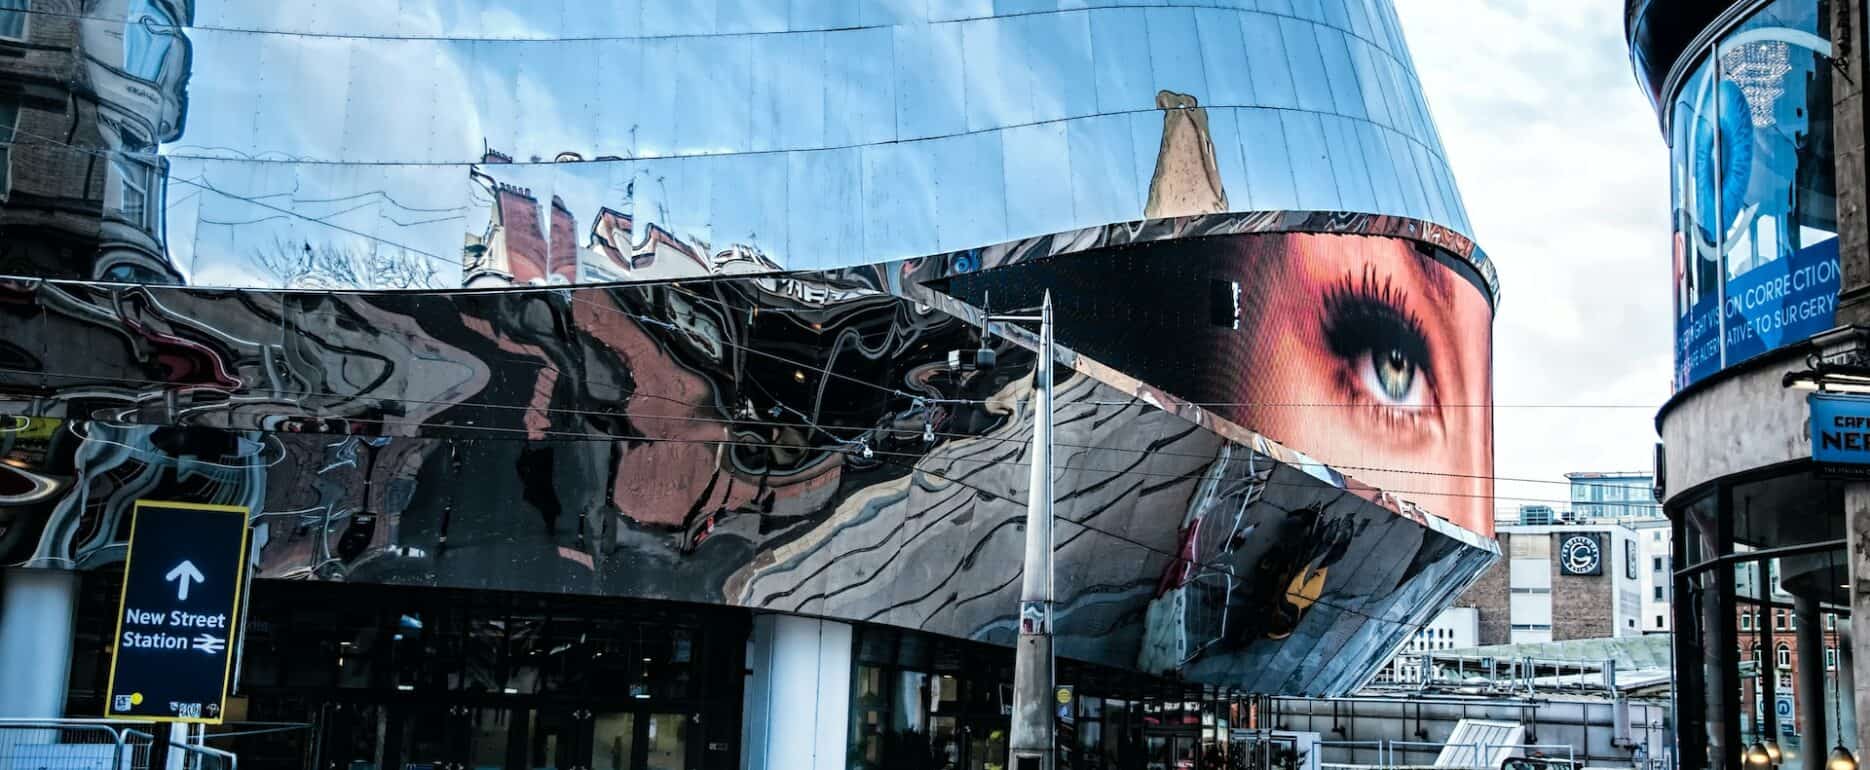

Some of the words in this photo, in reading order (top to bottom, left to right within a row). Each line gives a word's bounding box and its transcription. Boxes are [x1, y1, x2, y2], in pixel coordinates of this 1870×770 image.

[1708, 295, 1742, 328] VISON
[1745, 258, 1840, 309] CORRECTION
[1700, 321, 1752, 361] ALTERATIVE
[1755, 314, 1772, 333] TO
[1774, 293, 1835, 328] SURGERY
[122, 631, 188, 649] Station
[126, 608, 166, 625] New
[169, 610, 226, 628] Street
